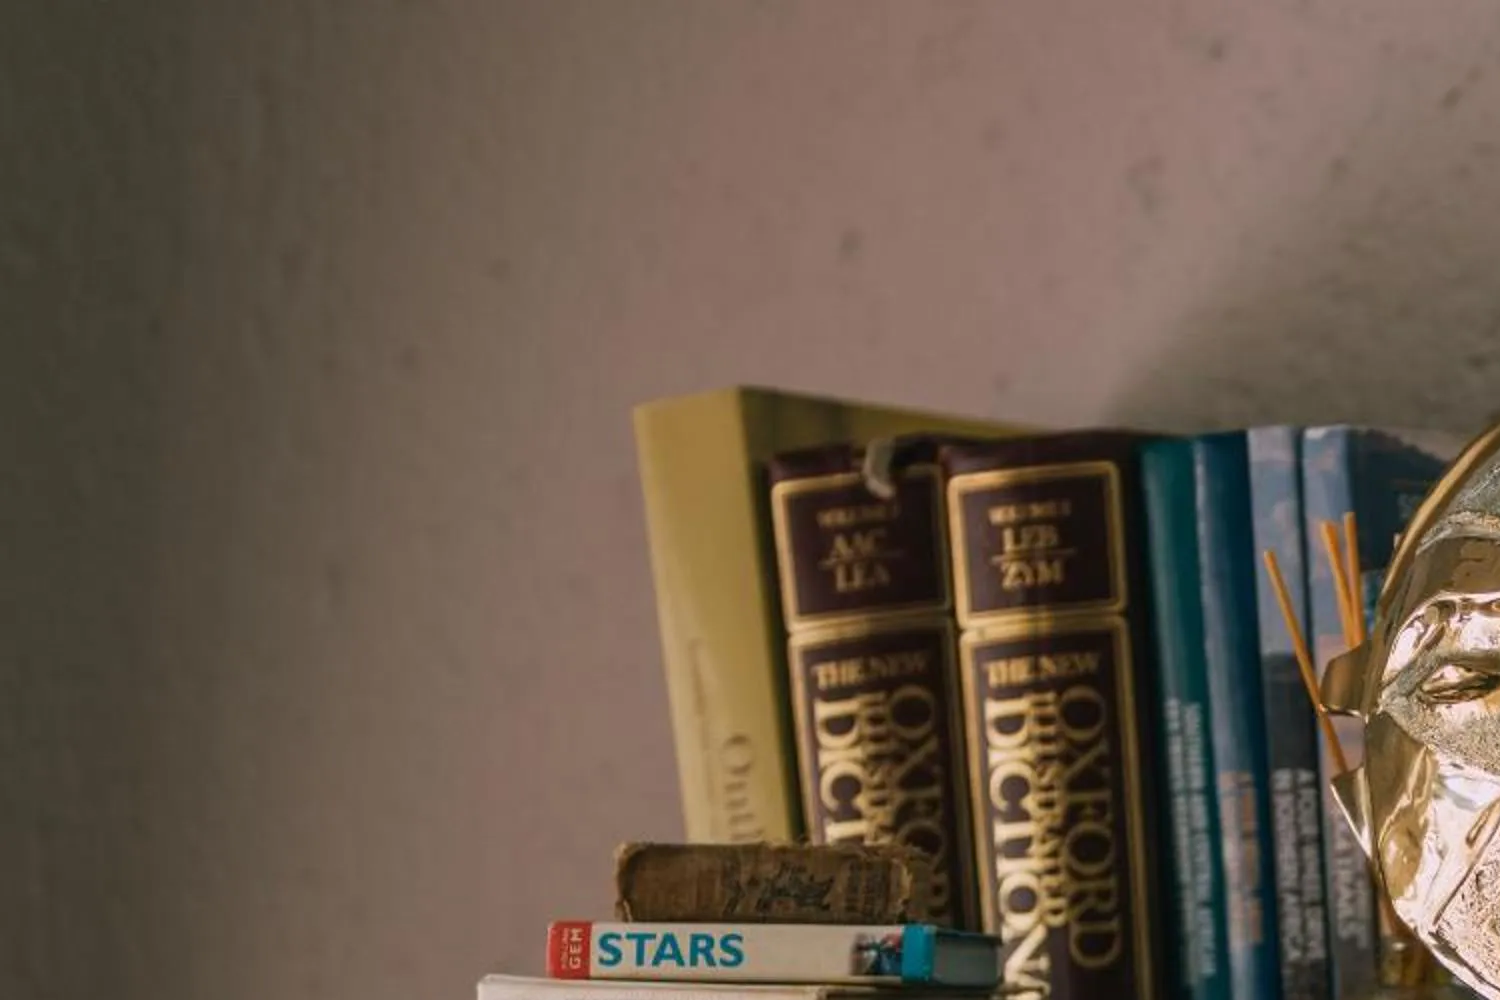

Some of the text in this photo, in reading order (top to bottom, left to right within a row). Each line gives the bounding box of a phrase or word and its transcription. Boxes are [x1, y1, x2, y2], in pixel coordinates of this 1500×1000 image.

[812, 657, 860, 690] THE
[984, 651, 1100, 688] THE NEW
[1058, 685, 1122, 968] OXFORD
[568, 927, 584, 970] GEM
[597, 931, 745, 968] STARS
